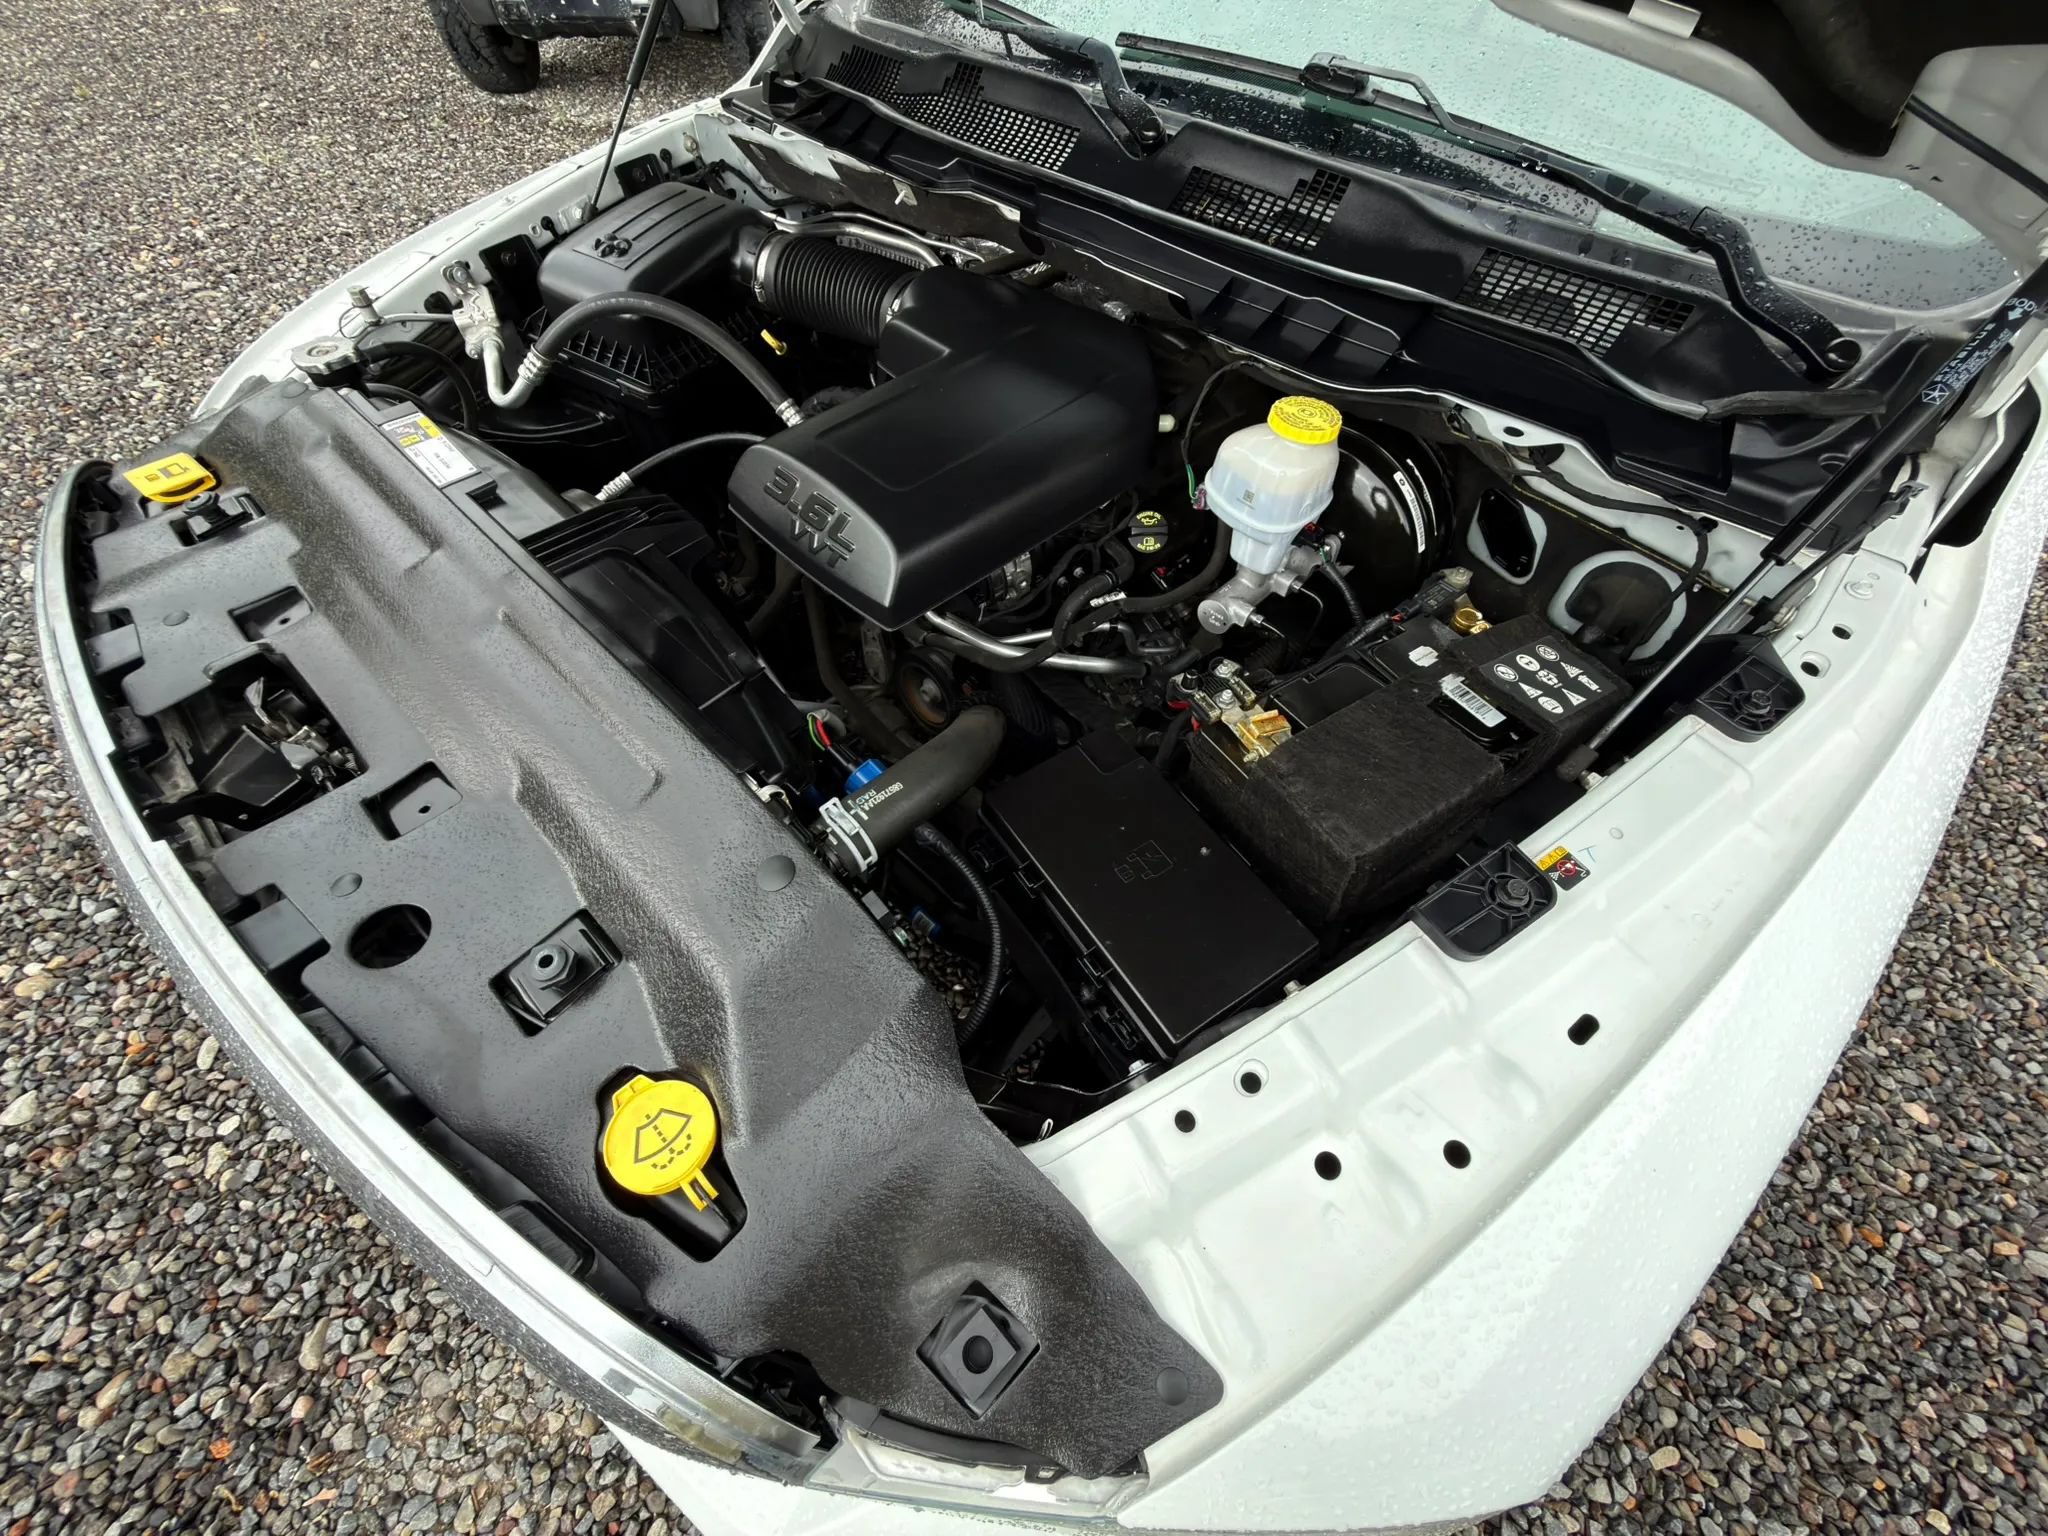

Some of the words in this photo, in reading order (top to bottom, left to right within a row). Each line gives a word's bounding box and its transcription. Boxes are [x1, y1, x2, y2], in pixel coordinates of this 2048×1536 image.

[2006, 298, 2038, 315] BODY
[1934, 323, 1996, 381] STABILUS
[764, 465, 856, 552] 3.6L
[1153, 511, 1161, 519] OIL
[789, 516, 850, 569] VVT
[855, 789, 876, 805] RAD
